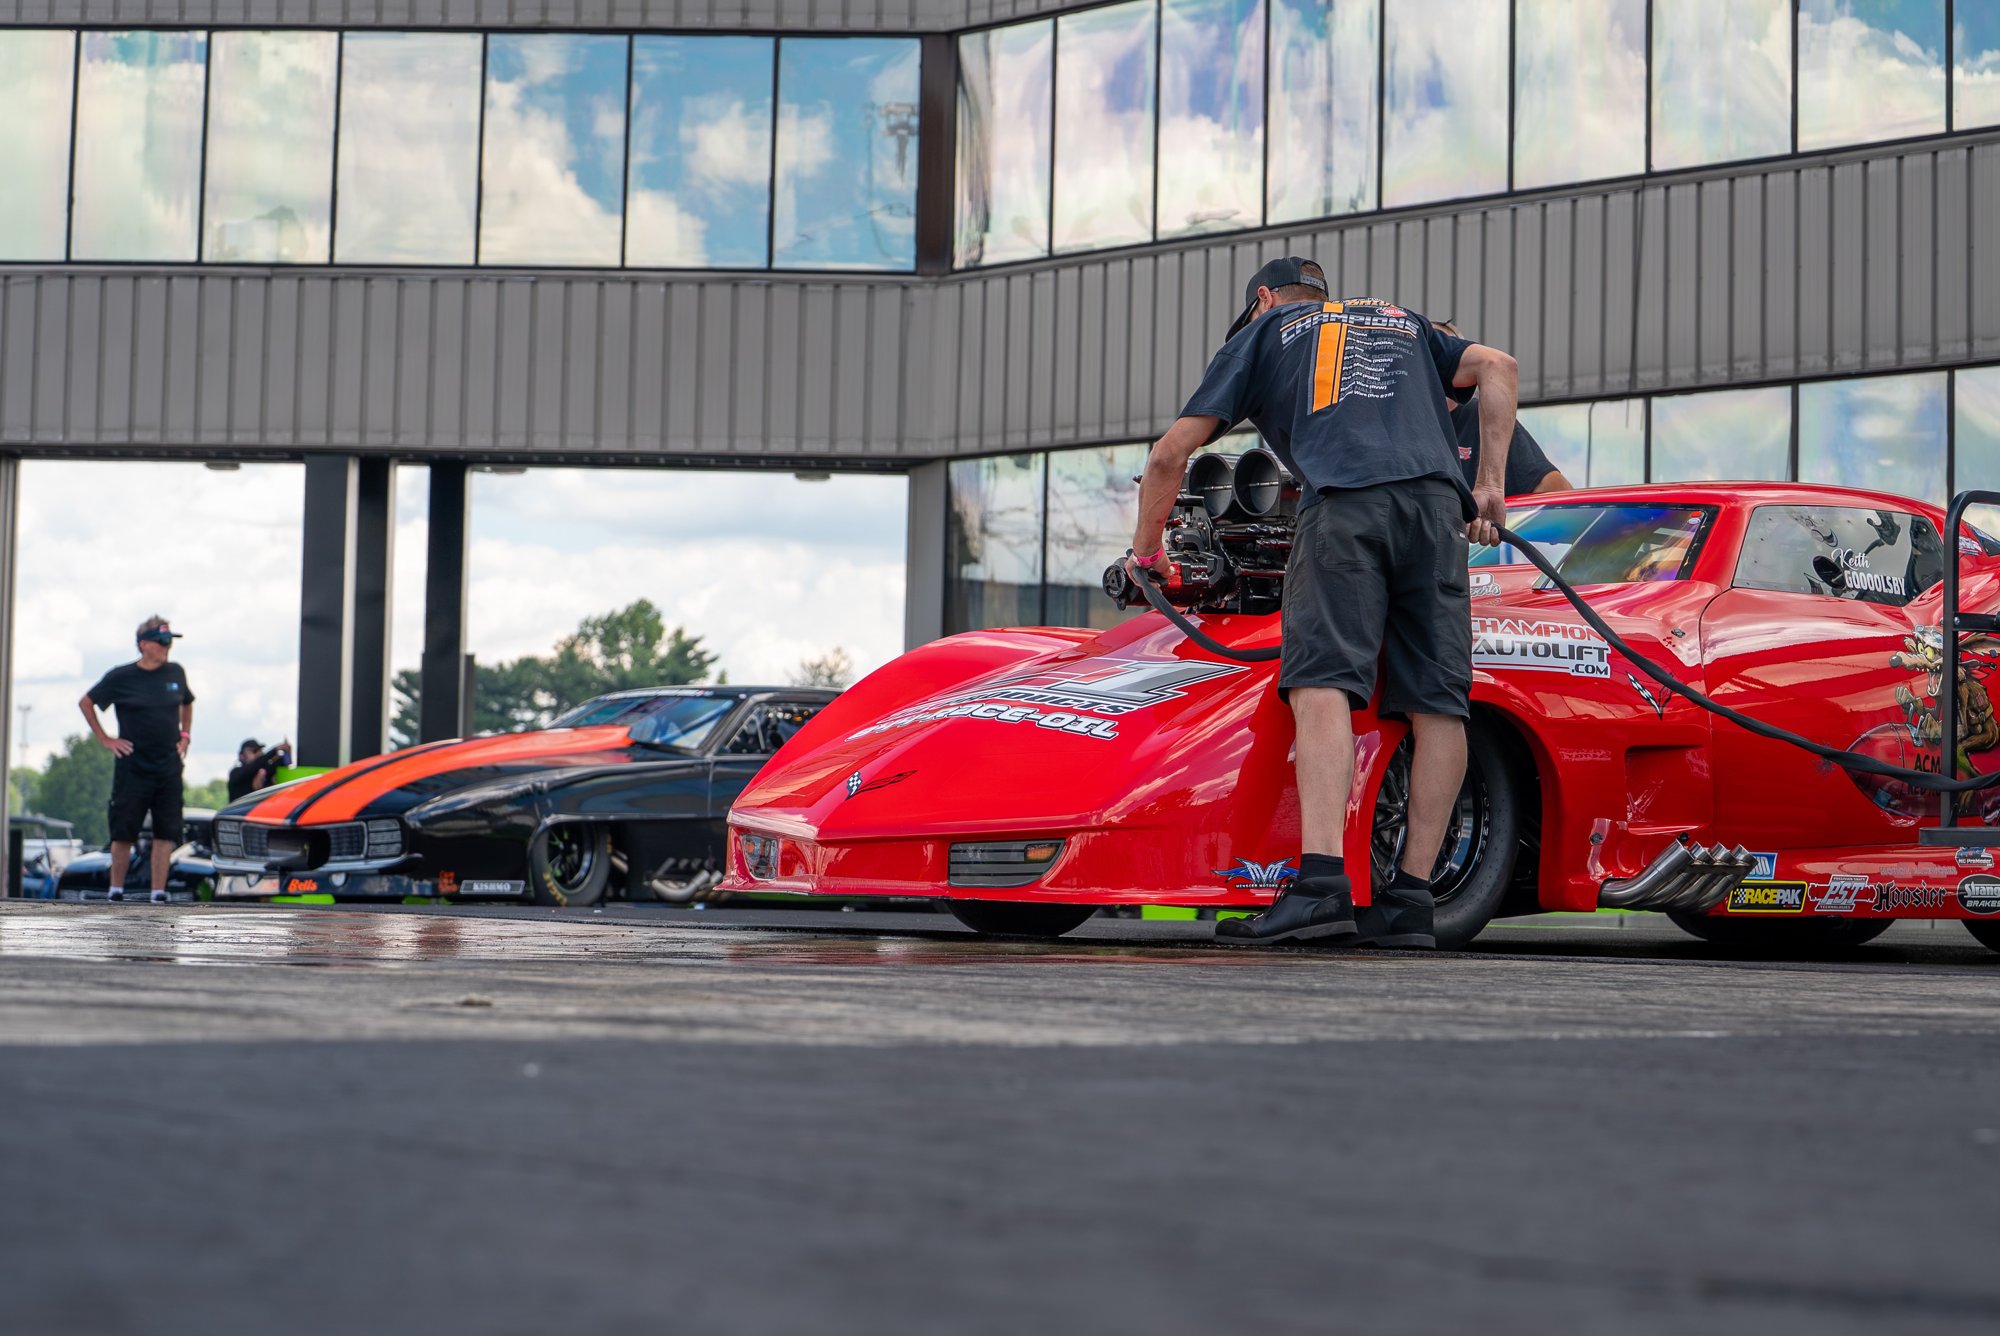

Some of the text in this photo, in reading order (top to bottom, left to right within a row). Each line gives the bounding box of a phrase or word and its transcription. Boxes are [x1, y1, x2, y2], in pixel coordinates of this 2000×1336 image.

[1281, 312, 1419, 345] CHAMPIONS
[1374, 344, 1415, 356] MITCHELL
[1372, 369, 1409, 378] DENTON
[1831, 547, 1870, 571] Keith
[1472, 638, 1609, 663] AUTOLIFT
[1571, 663, 1609, 676] .COM
[1744, 888, 1801, 905] RACEPAK
[1819, 881, 1865, 905] PST
[1872, 880, 1947, 912] Hoosier
